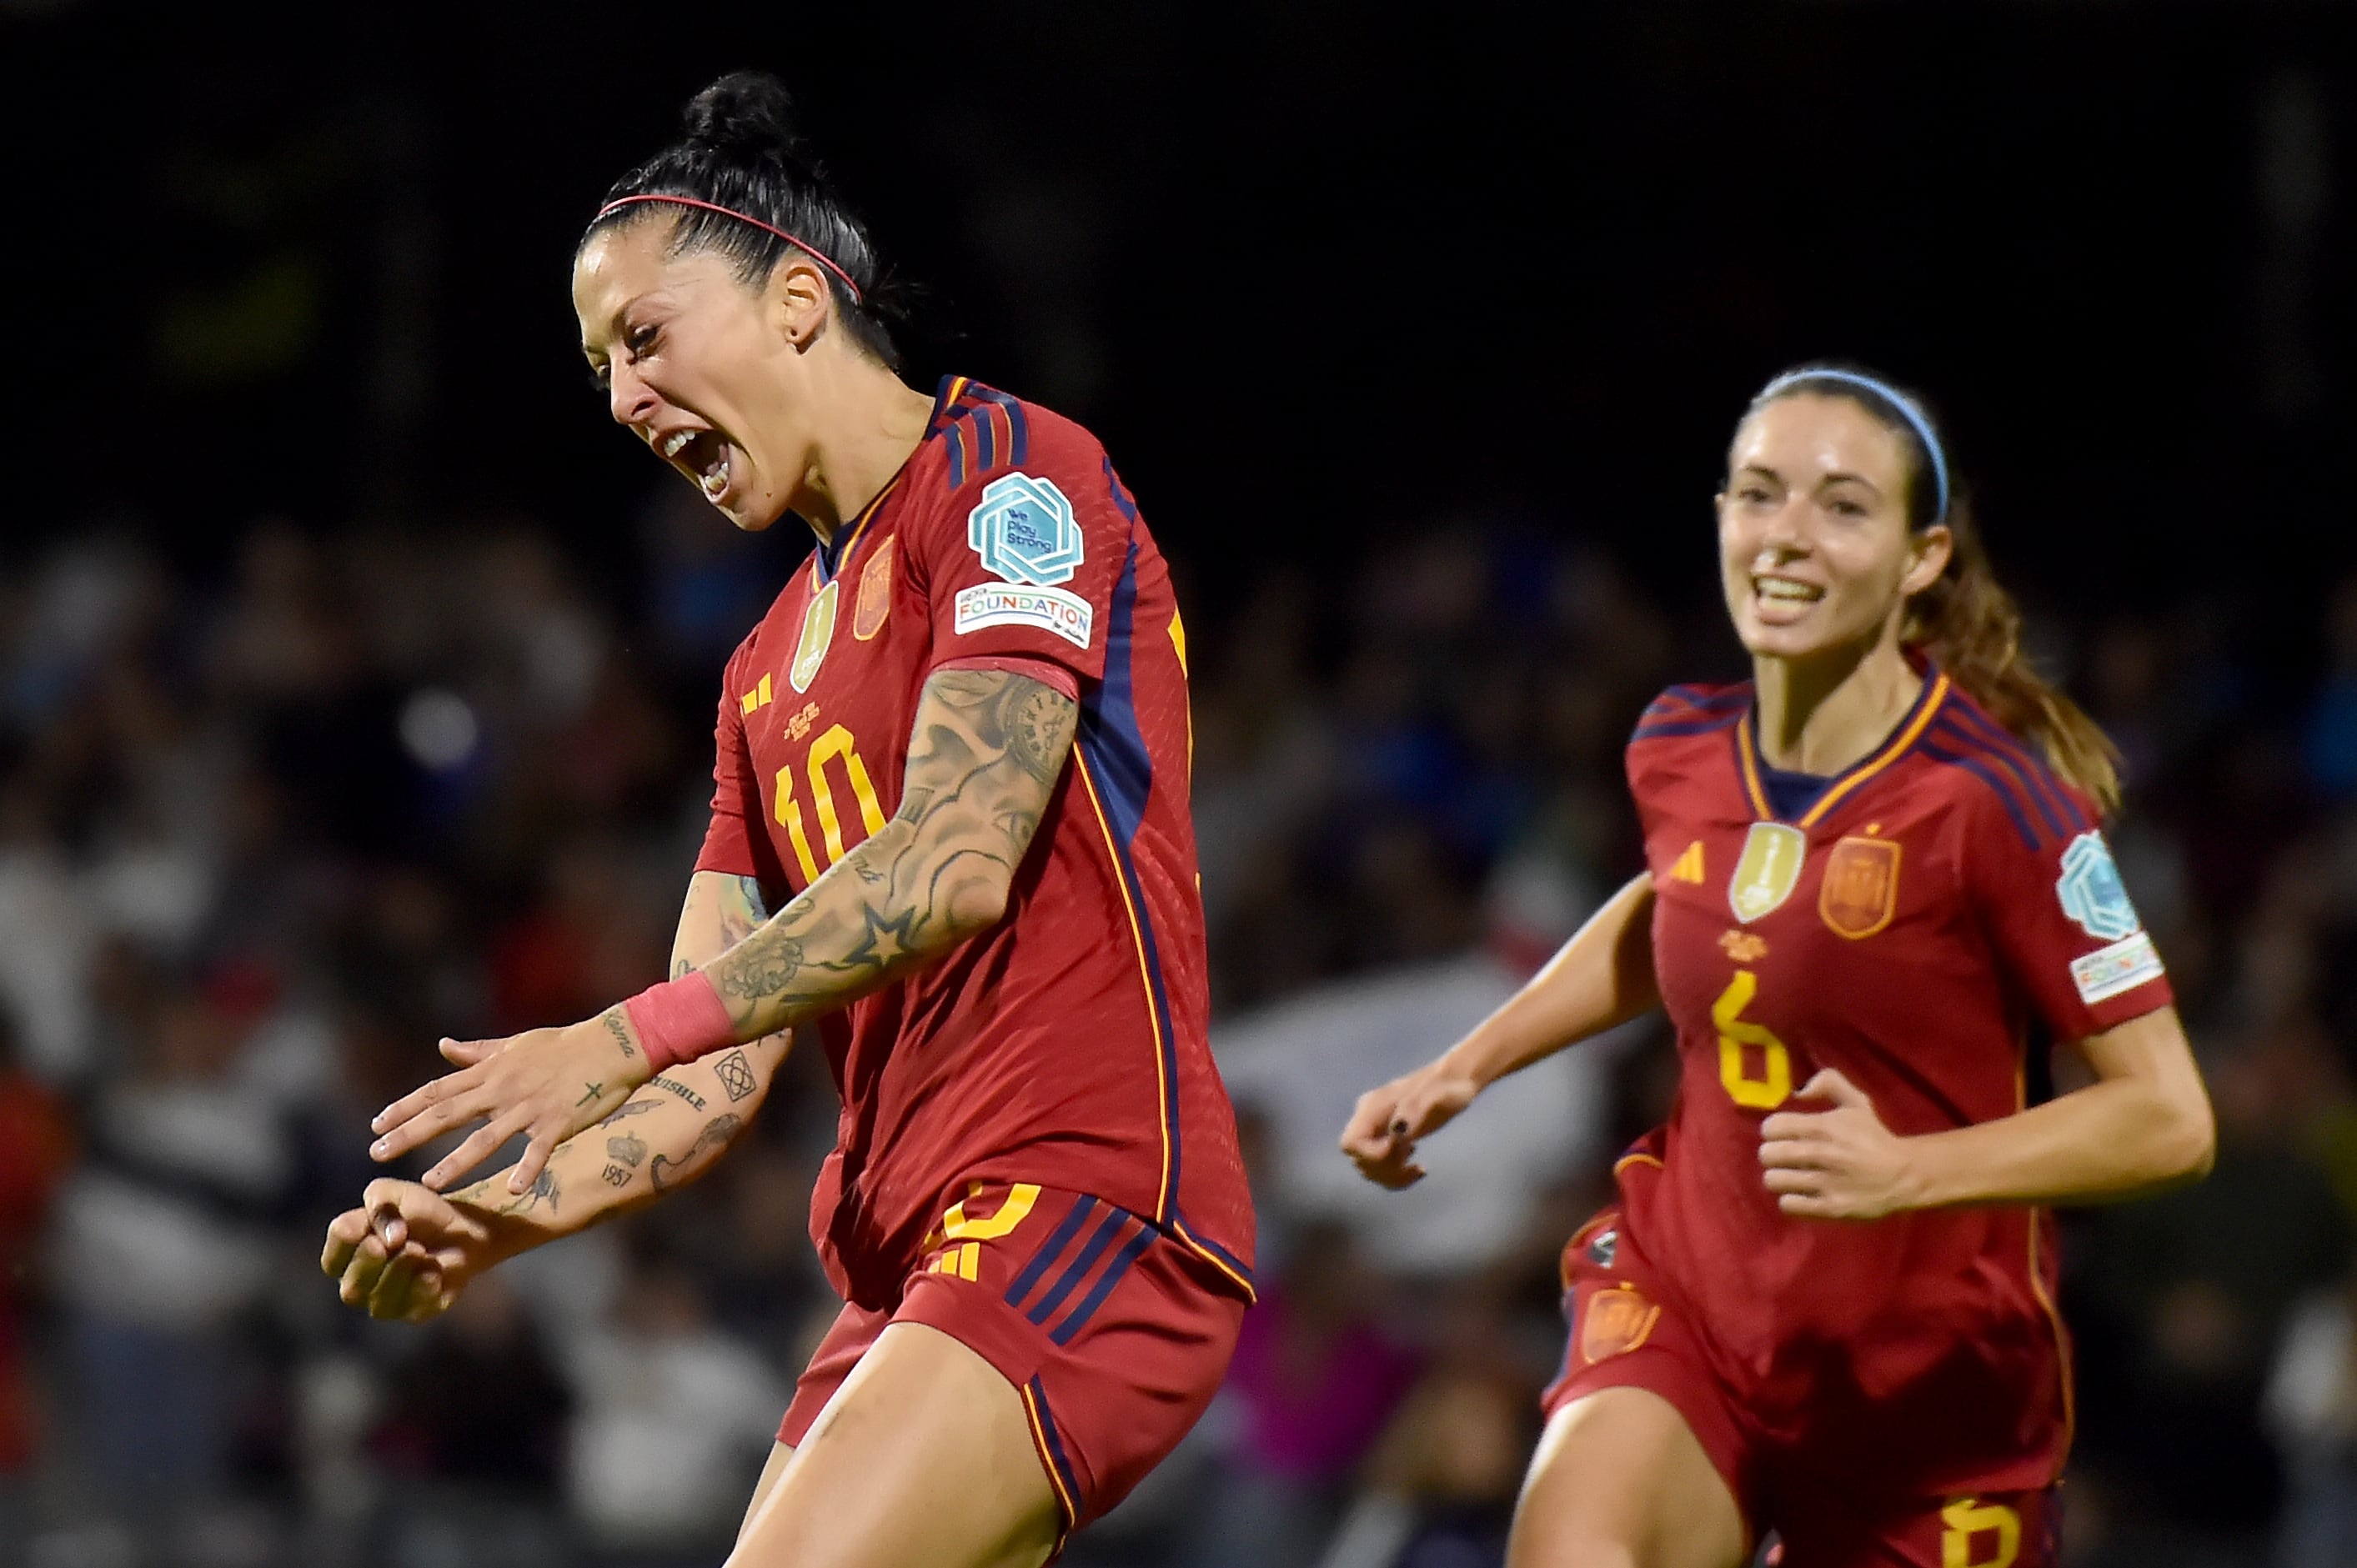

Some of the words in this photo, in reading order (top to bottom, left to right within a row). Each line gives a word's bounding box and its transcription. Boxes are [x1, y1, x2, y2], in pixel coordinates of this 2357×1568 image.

[960, 595, 1088, 632] FOUNDATION
[775, 723, 888, 884] 10
[1712, 969, 1791, 1110] 6
[602, 1164, 633, 1188] 1957
